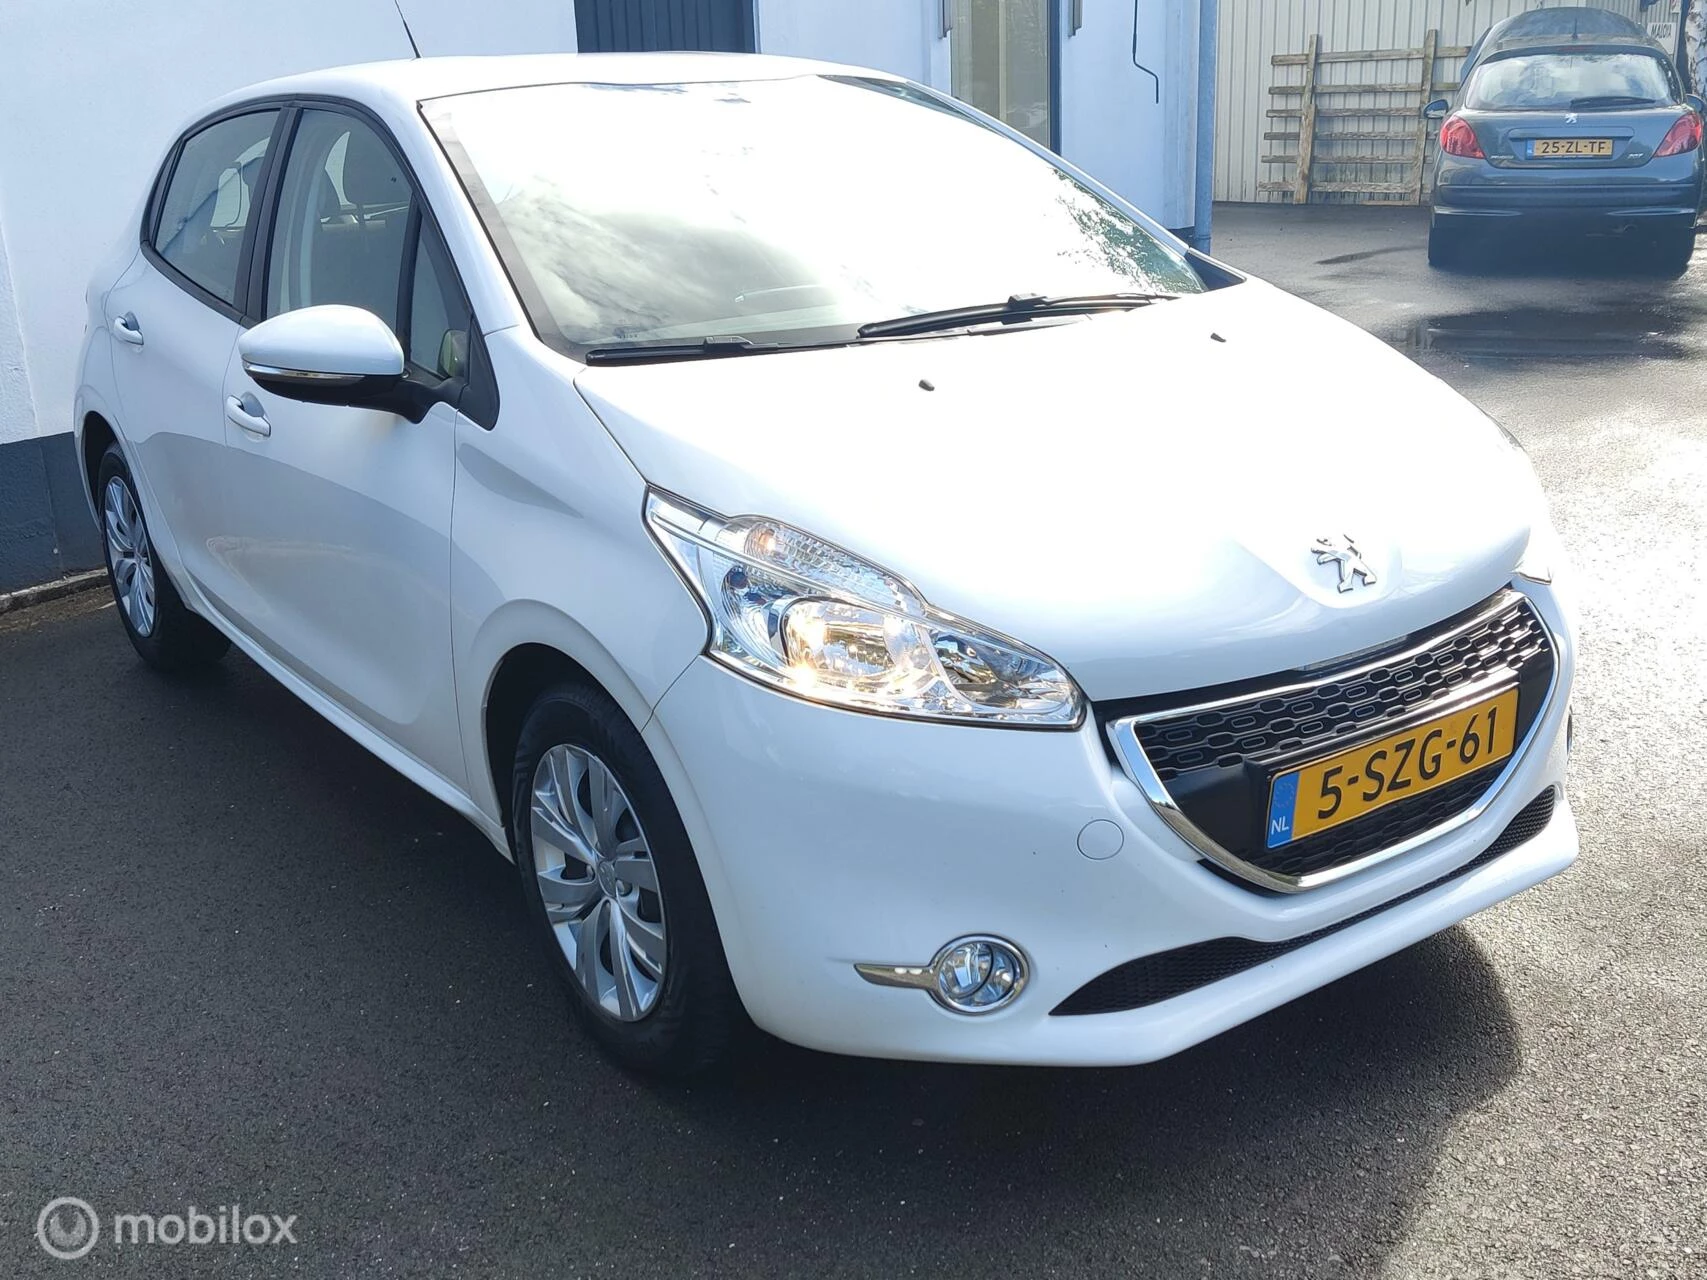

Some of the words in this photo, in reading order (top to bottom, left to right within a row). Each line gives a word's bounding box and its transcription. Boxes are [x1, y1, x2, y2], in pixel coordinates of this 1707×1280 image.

[1541, 141, 1606, 154] 25-ZL-TF
[1318, 706, 1497, 819] 5-SZG-61
[1271, 815, 1290, 835] NL
